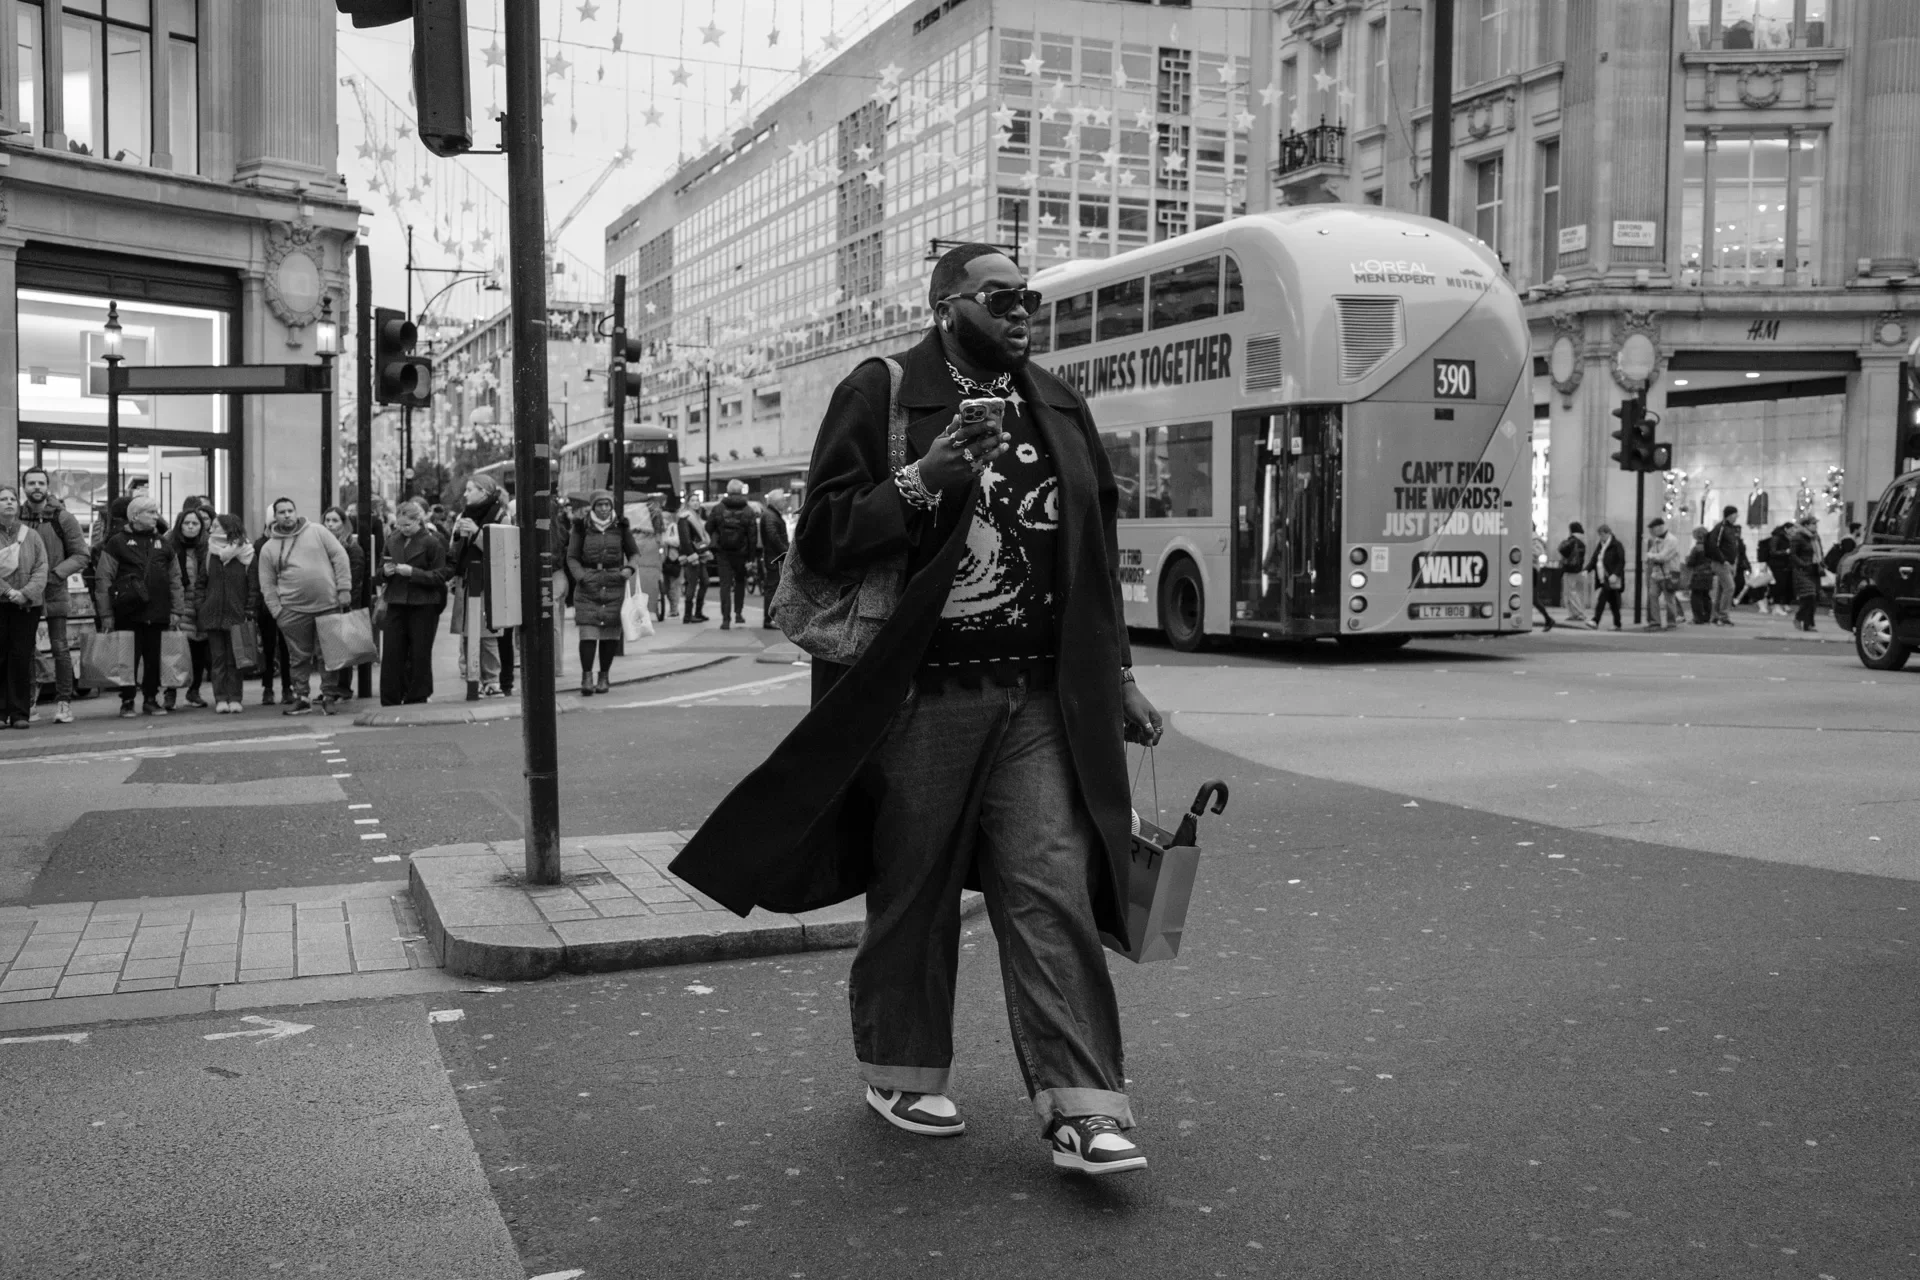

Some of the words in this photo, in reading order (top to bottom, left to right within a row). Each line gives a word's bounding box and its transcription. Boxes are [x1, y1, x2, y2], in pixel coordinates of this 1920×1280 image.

[1354, 274, 1386, 284] MEN
[1387, 274, 1436, 285] EXPERT
[1140, 332, 1232, 391] TOGETHER
[1436, 364, 1470, 396] 390
[632, 456, 647, 469] 98
[1401, 461, 1454, 485] CAN'T
[1457, 462, 1495, 484] FIND
[1393, 486, 1428, 510] THE
[1430, 486, 1501, 510] WORDS?
[1382, 511, 1426, 537] JUST
[1428, 511, 1470, 536] FIND
[1471, 511, 1509, 536] ONE.
[1418, 555, 1484, 584] WALK?
[1423, 606, 1442, 617] LTZ
